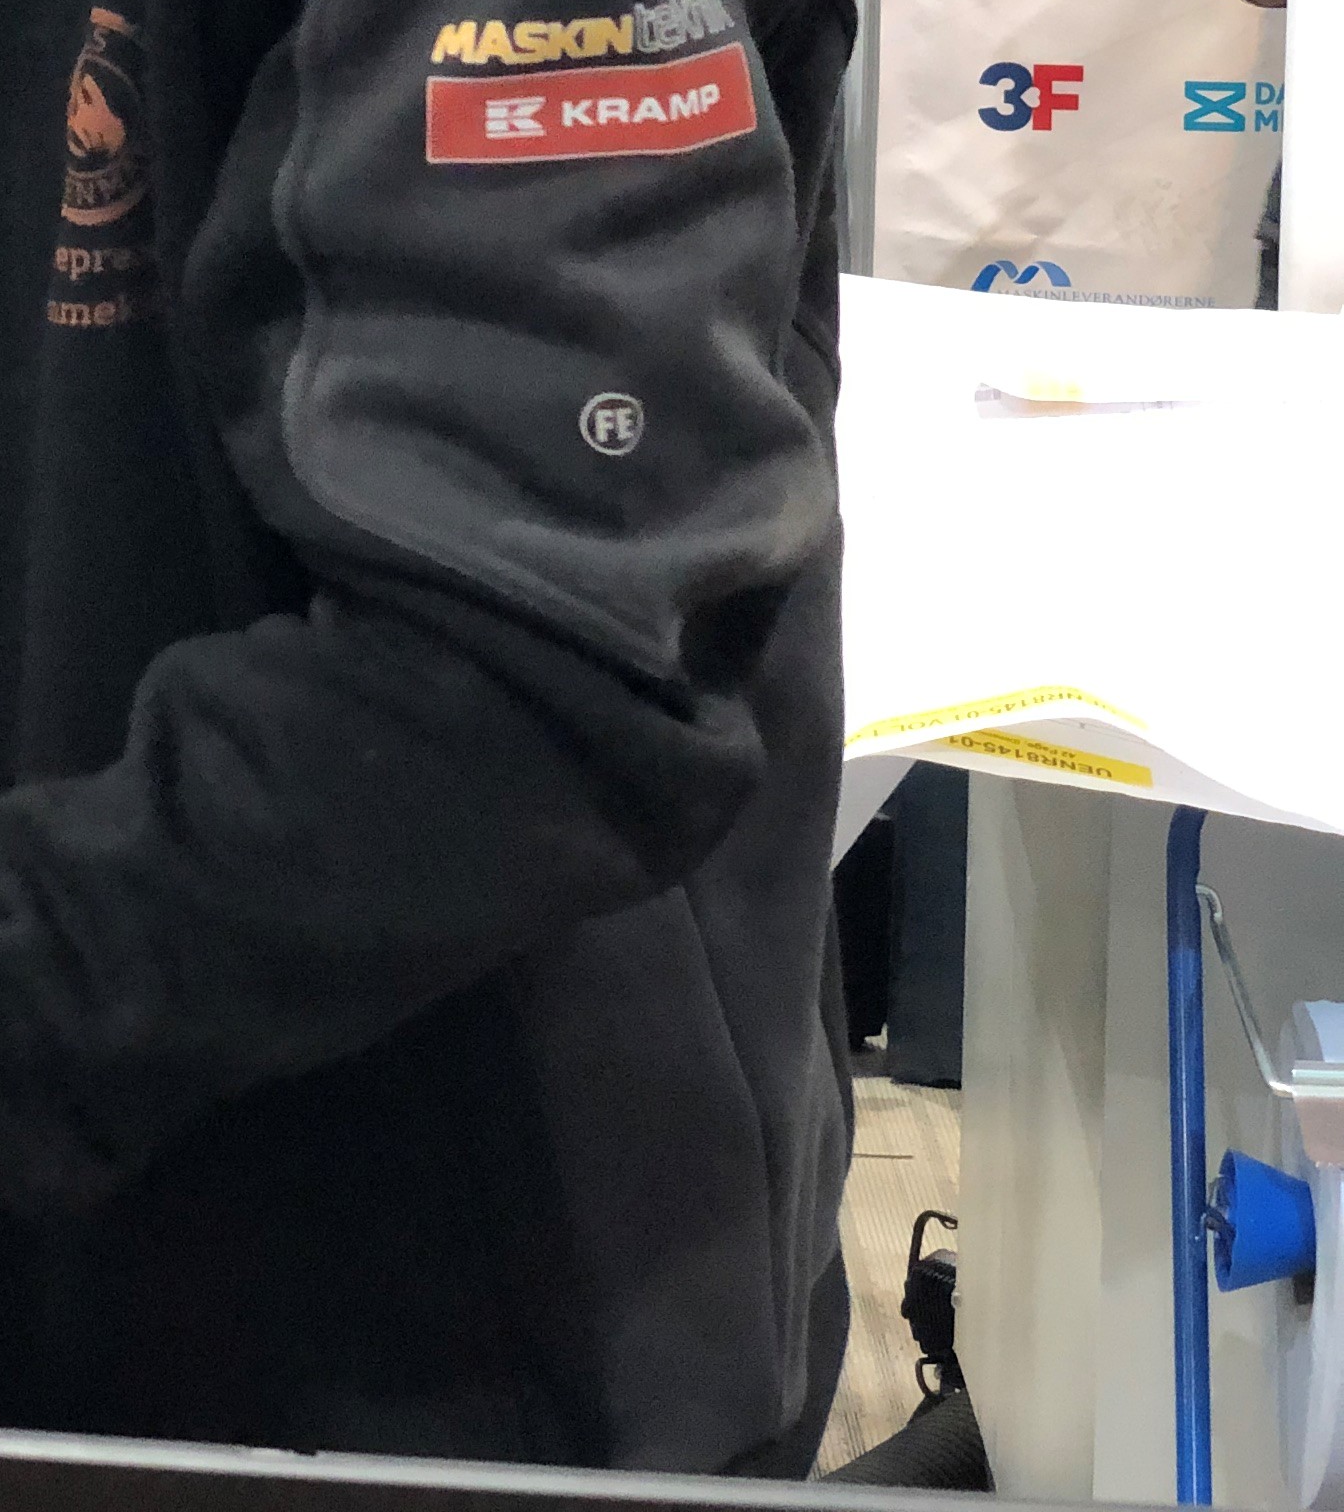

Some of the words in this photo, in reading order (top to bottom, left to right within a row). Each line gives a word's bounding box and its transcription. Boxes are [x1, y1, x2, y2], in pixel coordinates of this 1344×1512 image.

[562, 83, 720, 128] KRAMP
[977, 62, 1084, 132] 3F
[949, 735, 1112, 779] UENR8145-01
